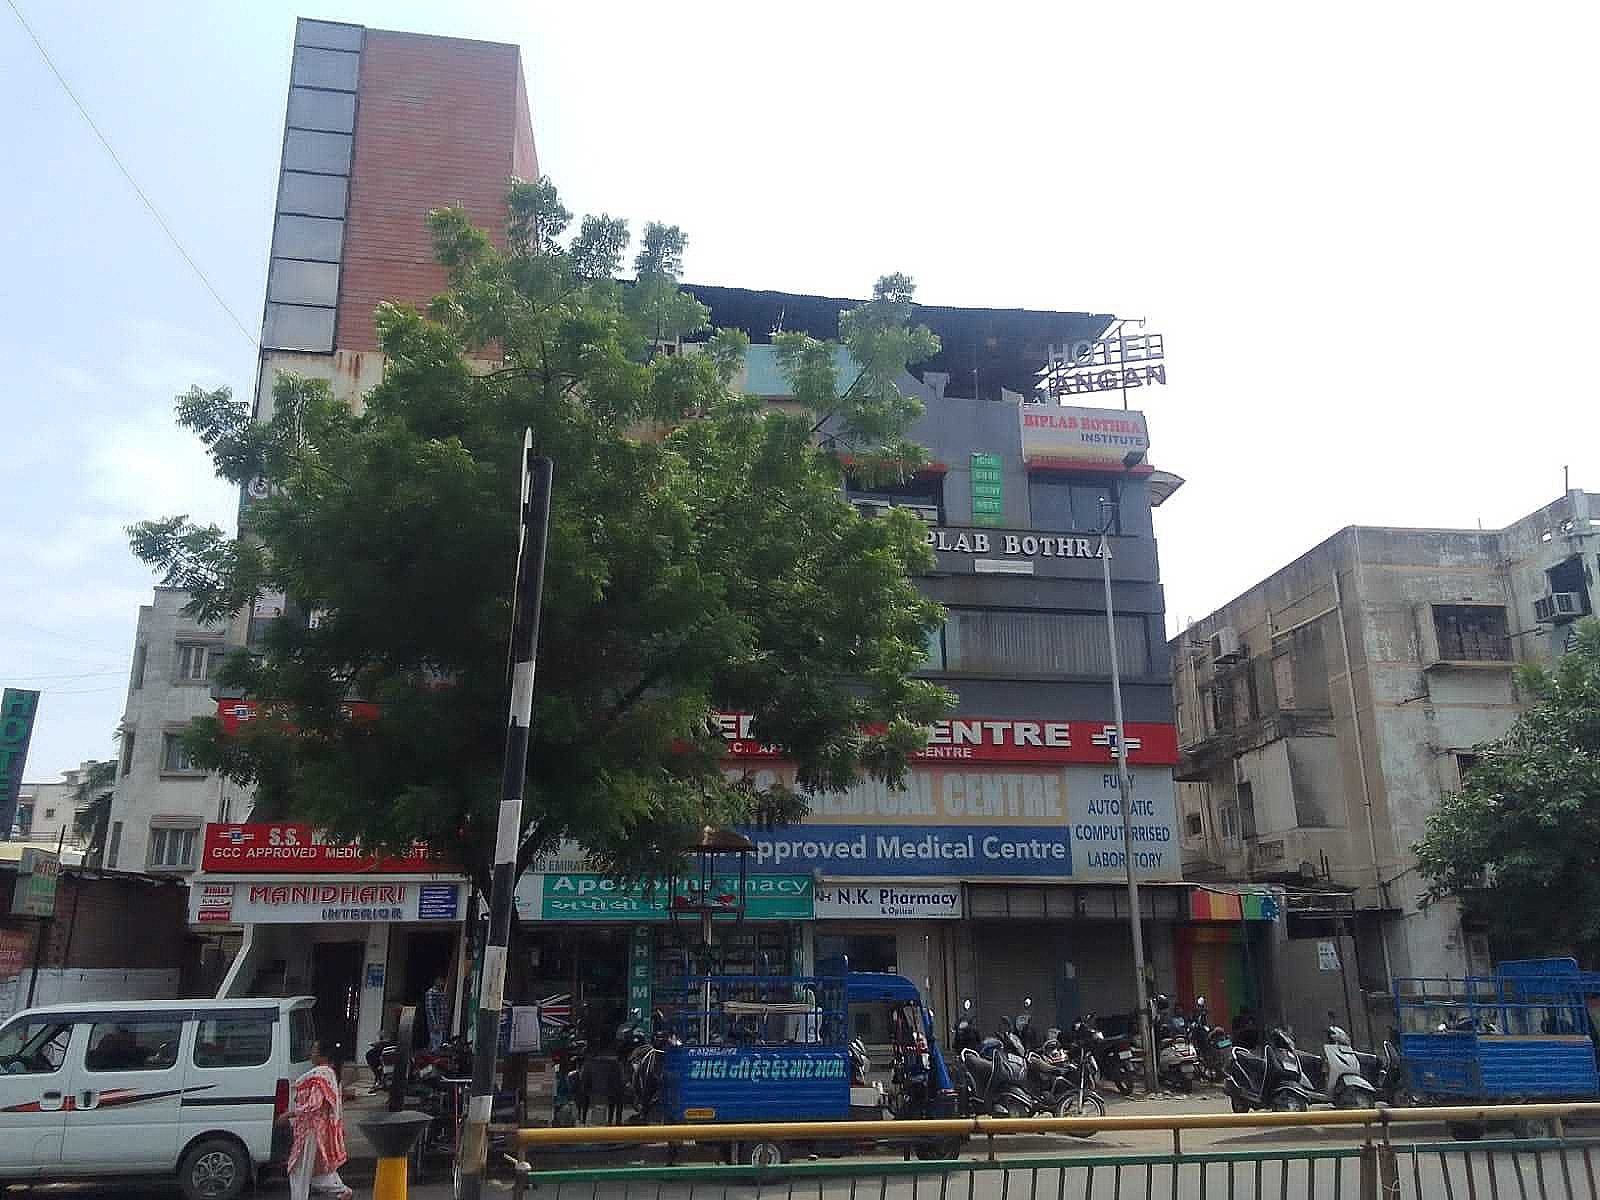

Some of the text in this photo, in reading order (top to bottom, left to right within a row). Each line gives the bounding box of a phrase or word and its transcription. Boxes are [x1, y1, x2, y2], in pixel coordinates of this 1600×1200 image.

[1047, 333, 1165, 368] HOTEL
[1053, 363, 1167, 395] ANGAN
[1024, 414, 1141, 433] BIPLAB BOTHRA
[1080, 431, 1144, 446] INSTITUTE
[920, 531, 1113, 560] PLAB BOTHRA
[927, 720, 1072, 747] ENTRE
[1103, 773, 1136, 789] FUY
[942, 773, 1065, 817] CENTRE
[1087, 799, 1154, 816] AUTOATIC
[268, 827, 301, 846] S.S.
[1075, 824, 1171, 842] COMPUTRRISED
[212, 847, 242, 859] GCC
[246, 847, 317, 859] APPROVED
[755, 834, 1066, 865] pproved Medical Centre
[1087, 850, 1163, 869] LABORTORY
[248, 886, 406, 904] MANIDHARI
[838, 888, 873, 905] N.K.
[879, 888, 958, 907] Pharmacy
[321, 907, 402, 920] INTERIOR
